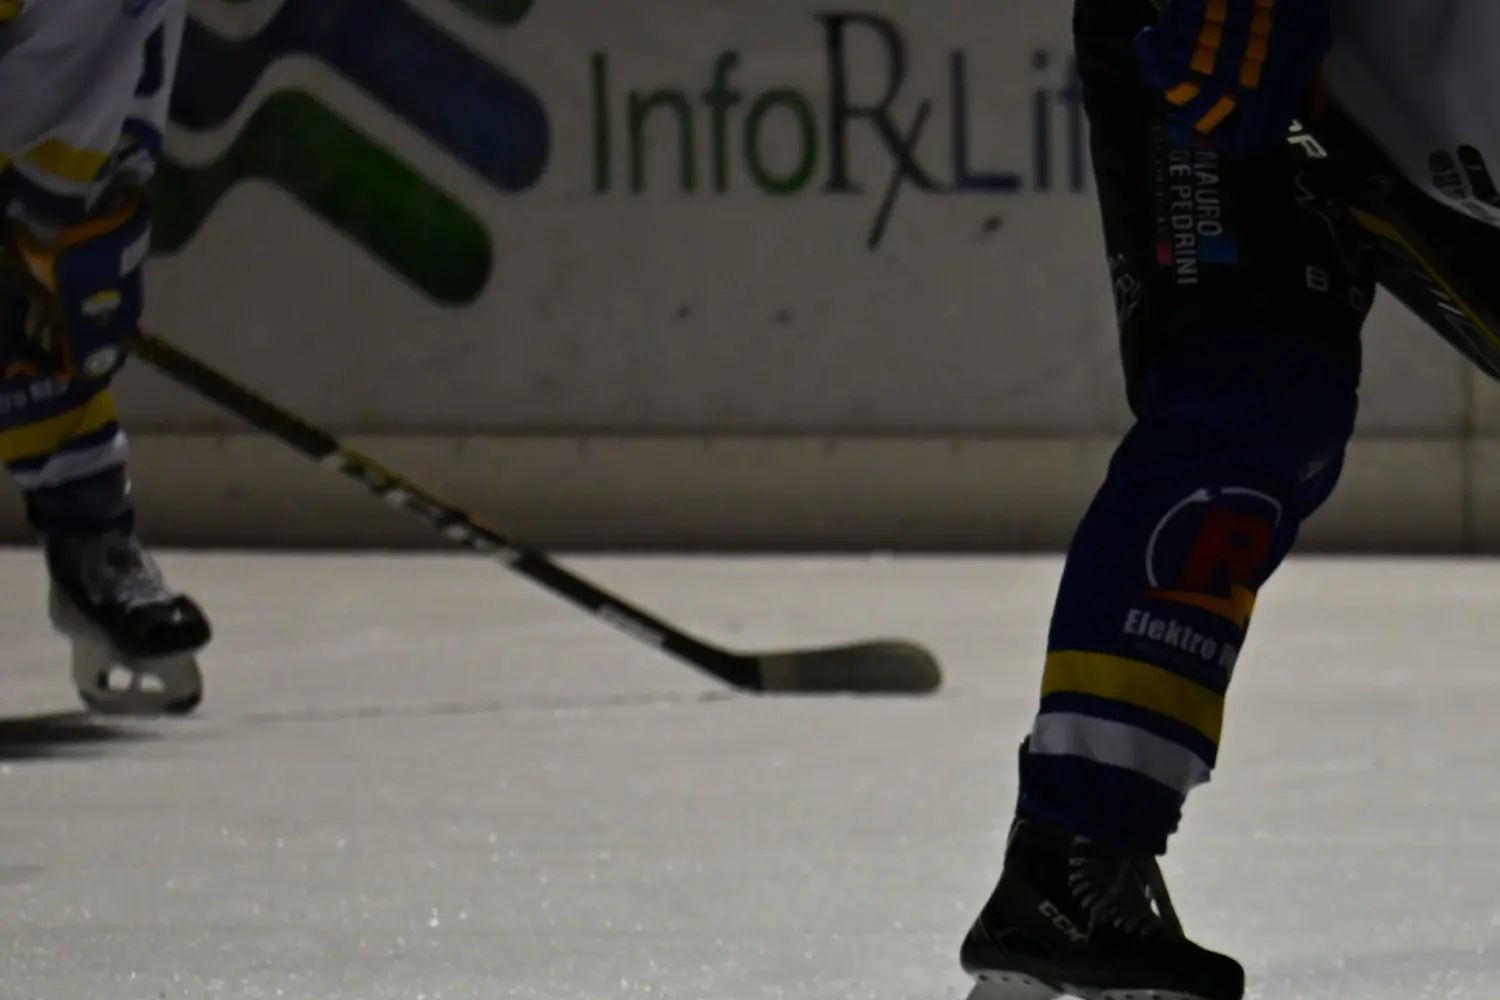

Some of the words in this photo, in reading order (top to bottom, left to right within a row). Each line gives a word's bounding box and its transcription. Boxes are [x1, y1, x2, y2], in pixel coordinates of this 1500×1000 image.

[1171, 182, 1198, 285] PEDRINI
[1194, 150, 1223, 237] MAURO
[1122, 607, 1217, 661] Elektro
